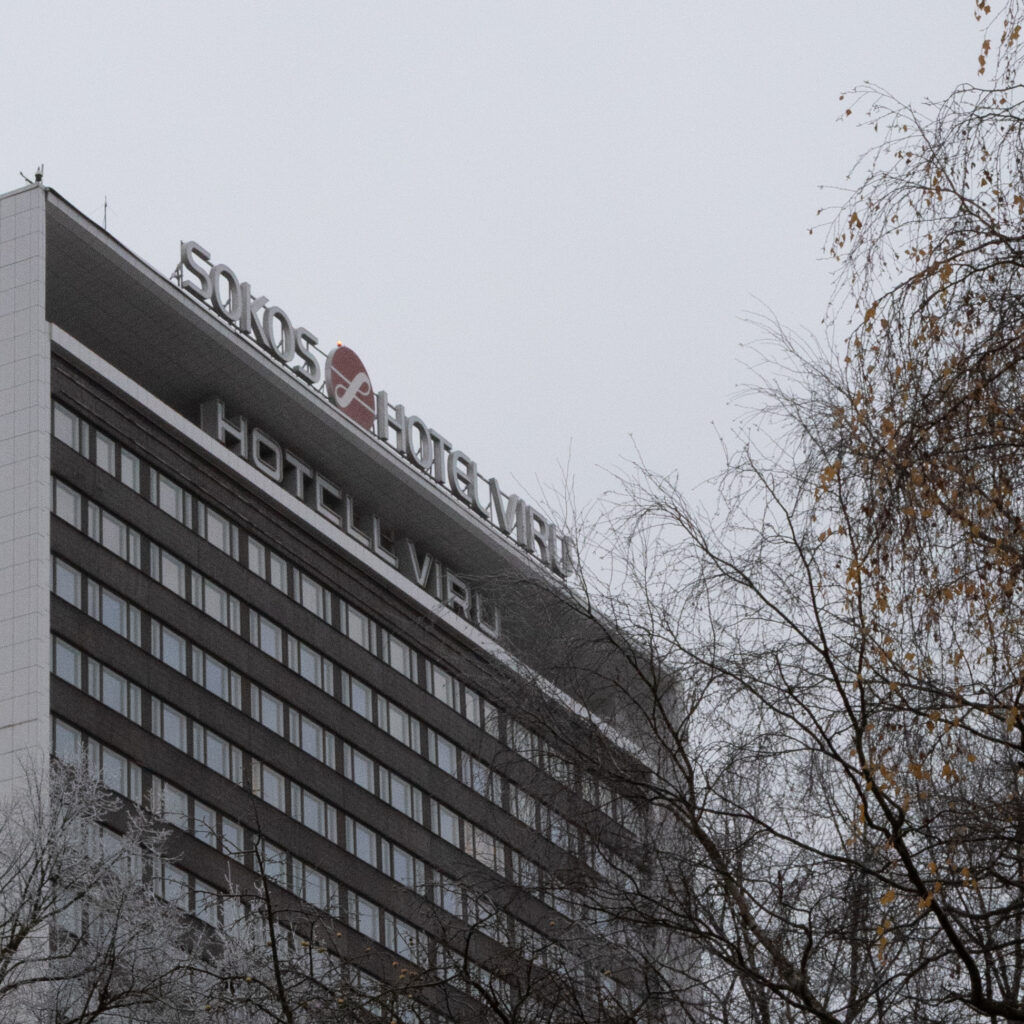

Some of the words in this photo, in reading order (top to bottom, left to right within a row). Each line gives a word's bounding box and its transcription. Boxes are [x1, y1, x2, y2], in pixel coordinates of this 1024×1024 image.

[181, 240, 322, 385] SOKOS
[376, 390, 490, 519] HOTEL
[488, 477, 576, 579] VIRU
[404, 539, 502, 640] VIRU
